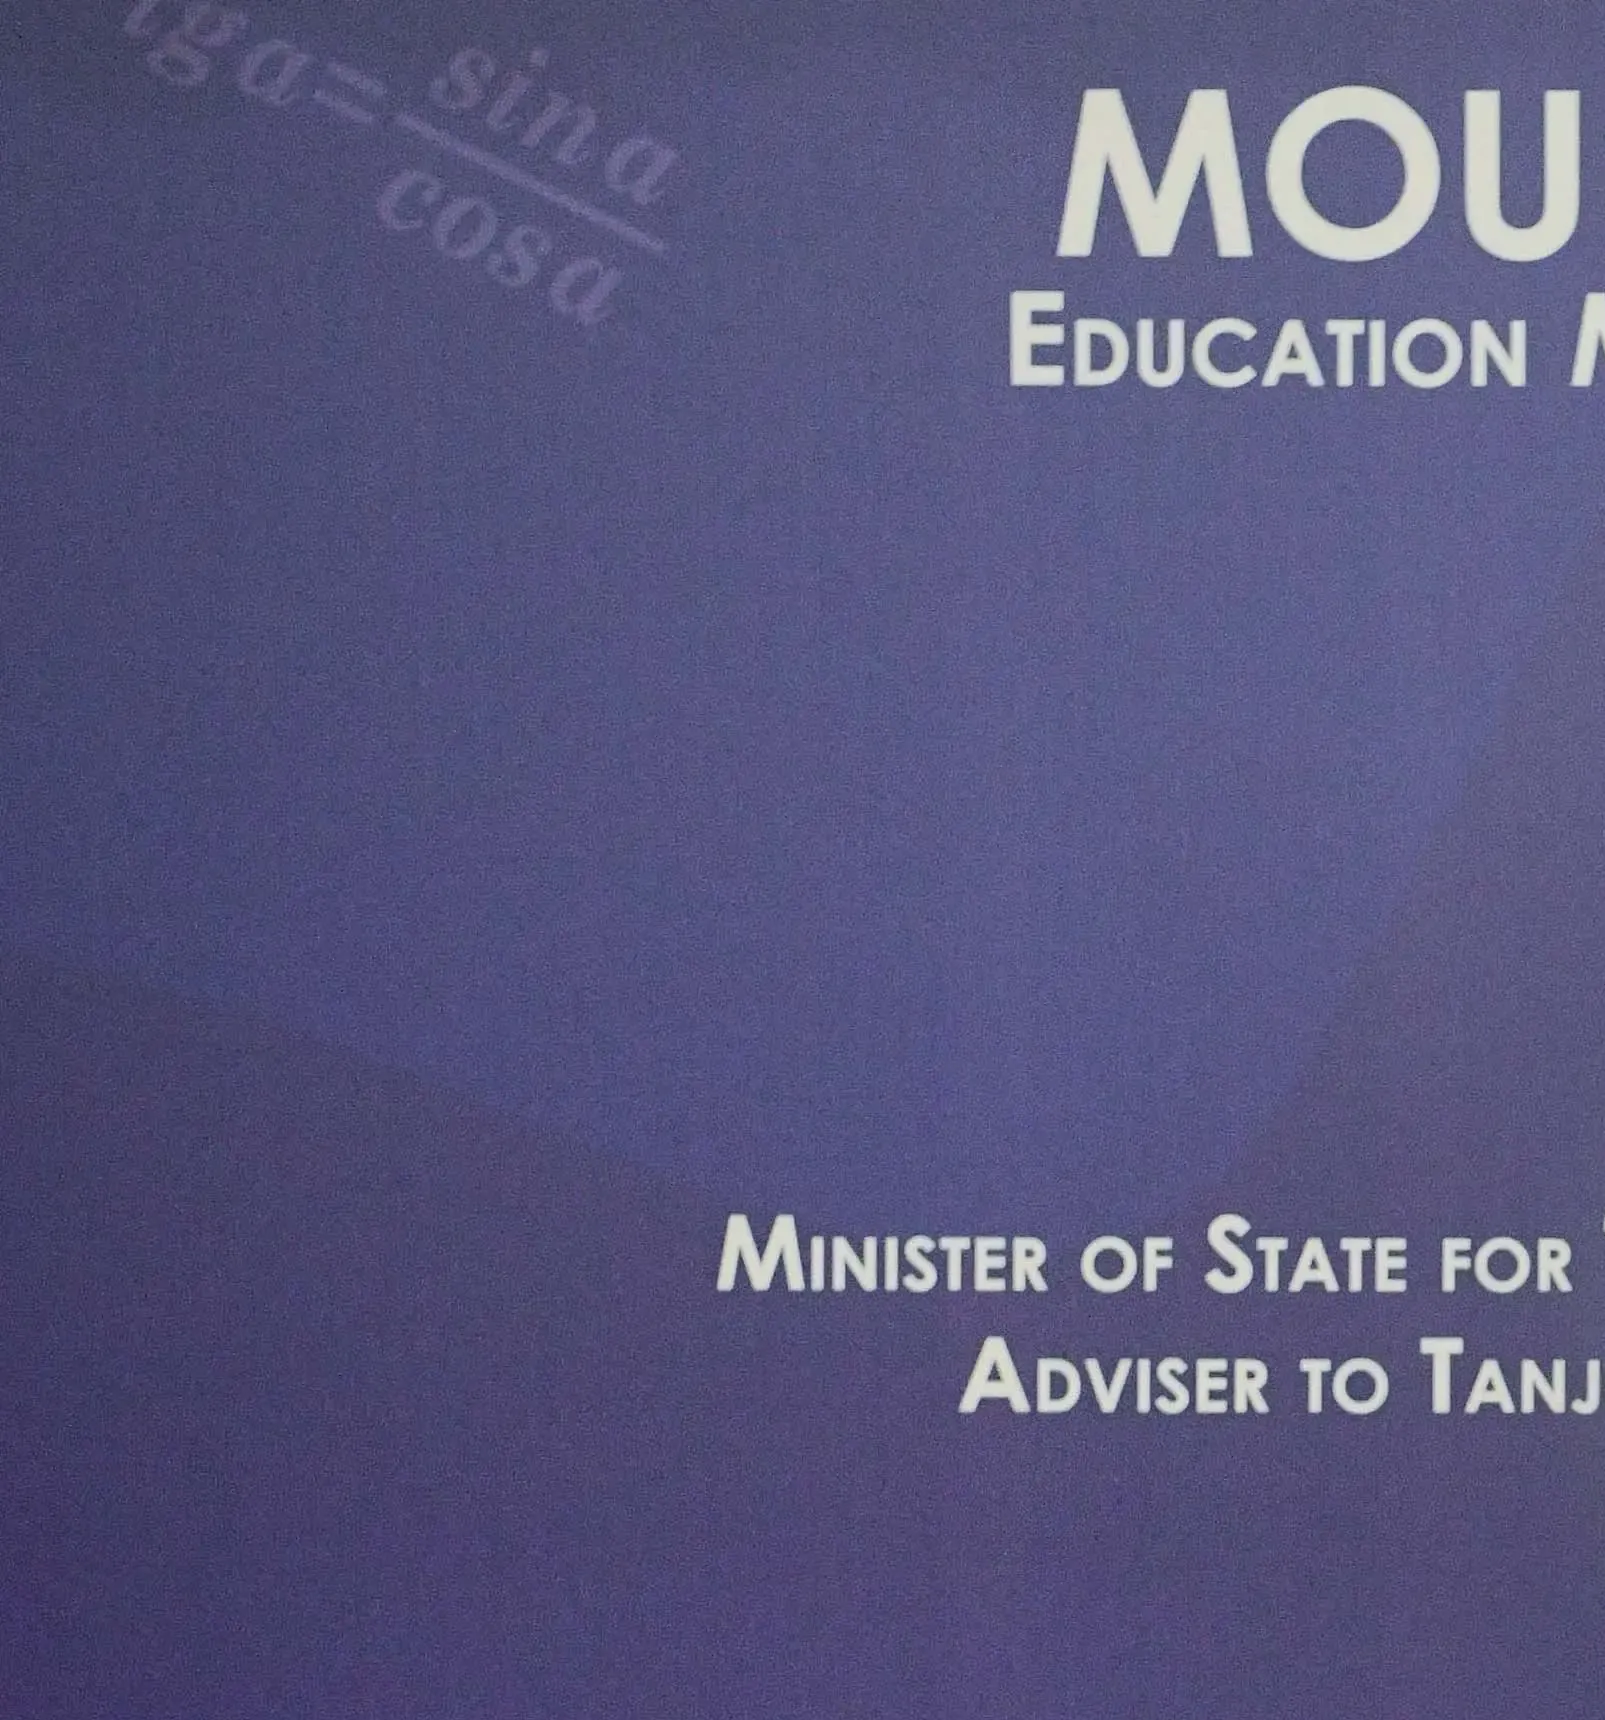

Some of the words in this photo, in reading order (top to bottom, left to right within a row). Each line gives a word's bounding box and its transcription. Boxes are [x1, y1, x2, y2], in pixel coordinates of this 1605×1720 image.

[1010, 290, 1527, 388] EDUCATION
[717, 1214, 1048, 1293] MINISTER
[1080, 1236, 1173, 1293] OF
[1205, 1214, 1407, 1294] STATE
[1442, 1237, 1573, 1294] FOR
[958, 1336, 1270, 1414] ADVISER
[1299, 1358, 1389, 1415] TO
